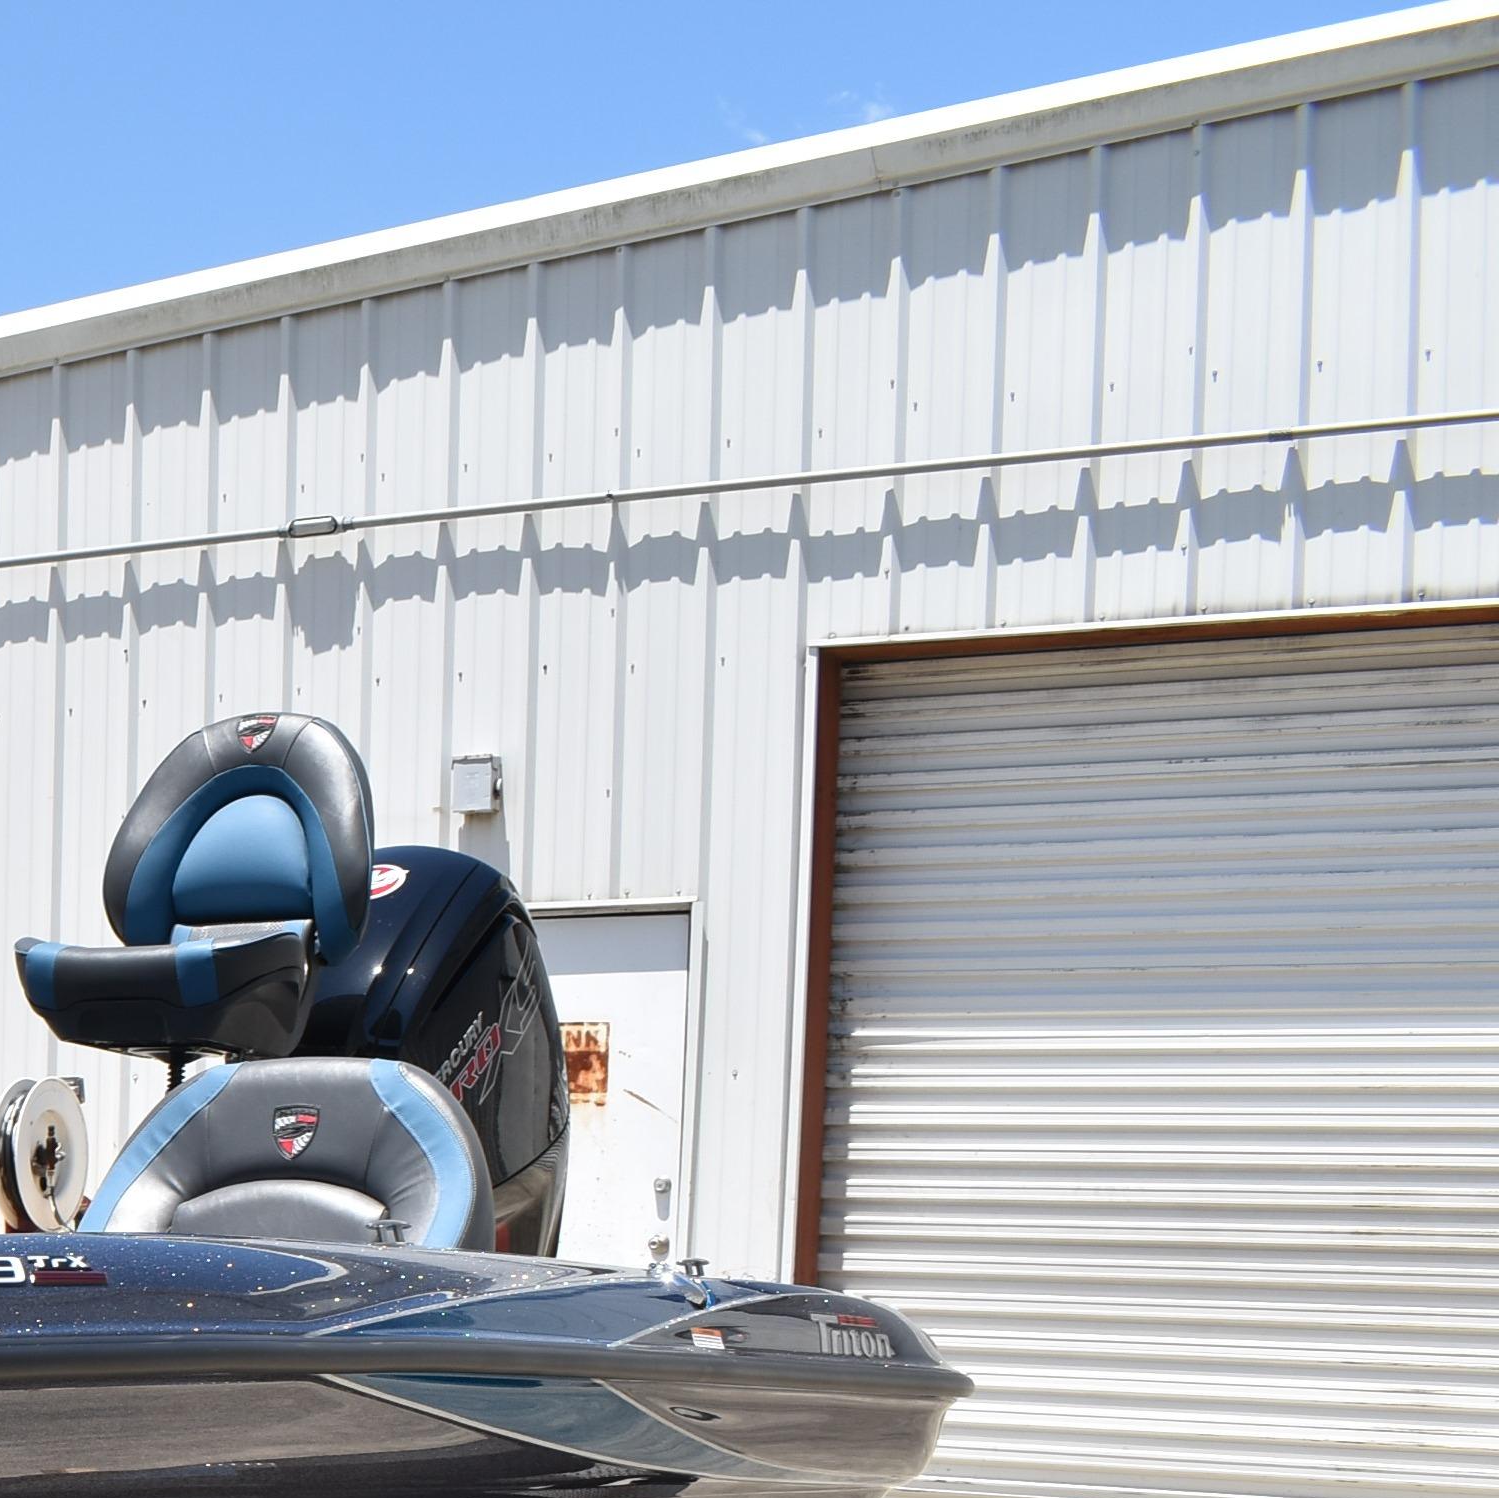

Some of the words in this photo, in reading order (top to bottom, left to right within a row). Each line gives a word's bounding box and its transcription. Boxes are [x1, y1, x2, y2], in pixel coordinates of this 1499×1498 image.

[434, 1011, 485, 1084] ERCURY
[450, 1022, 502, 1103] RO
[810, 1313, 896, 1358] Triton
